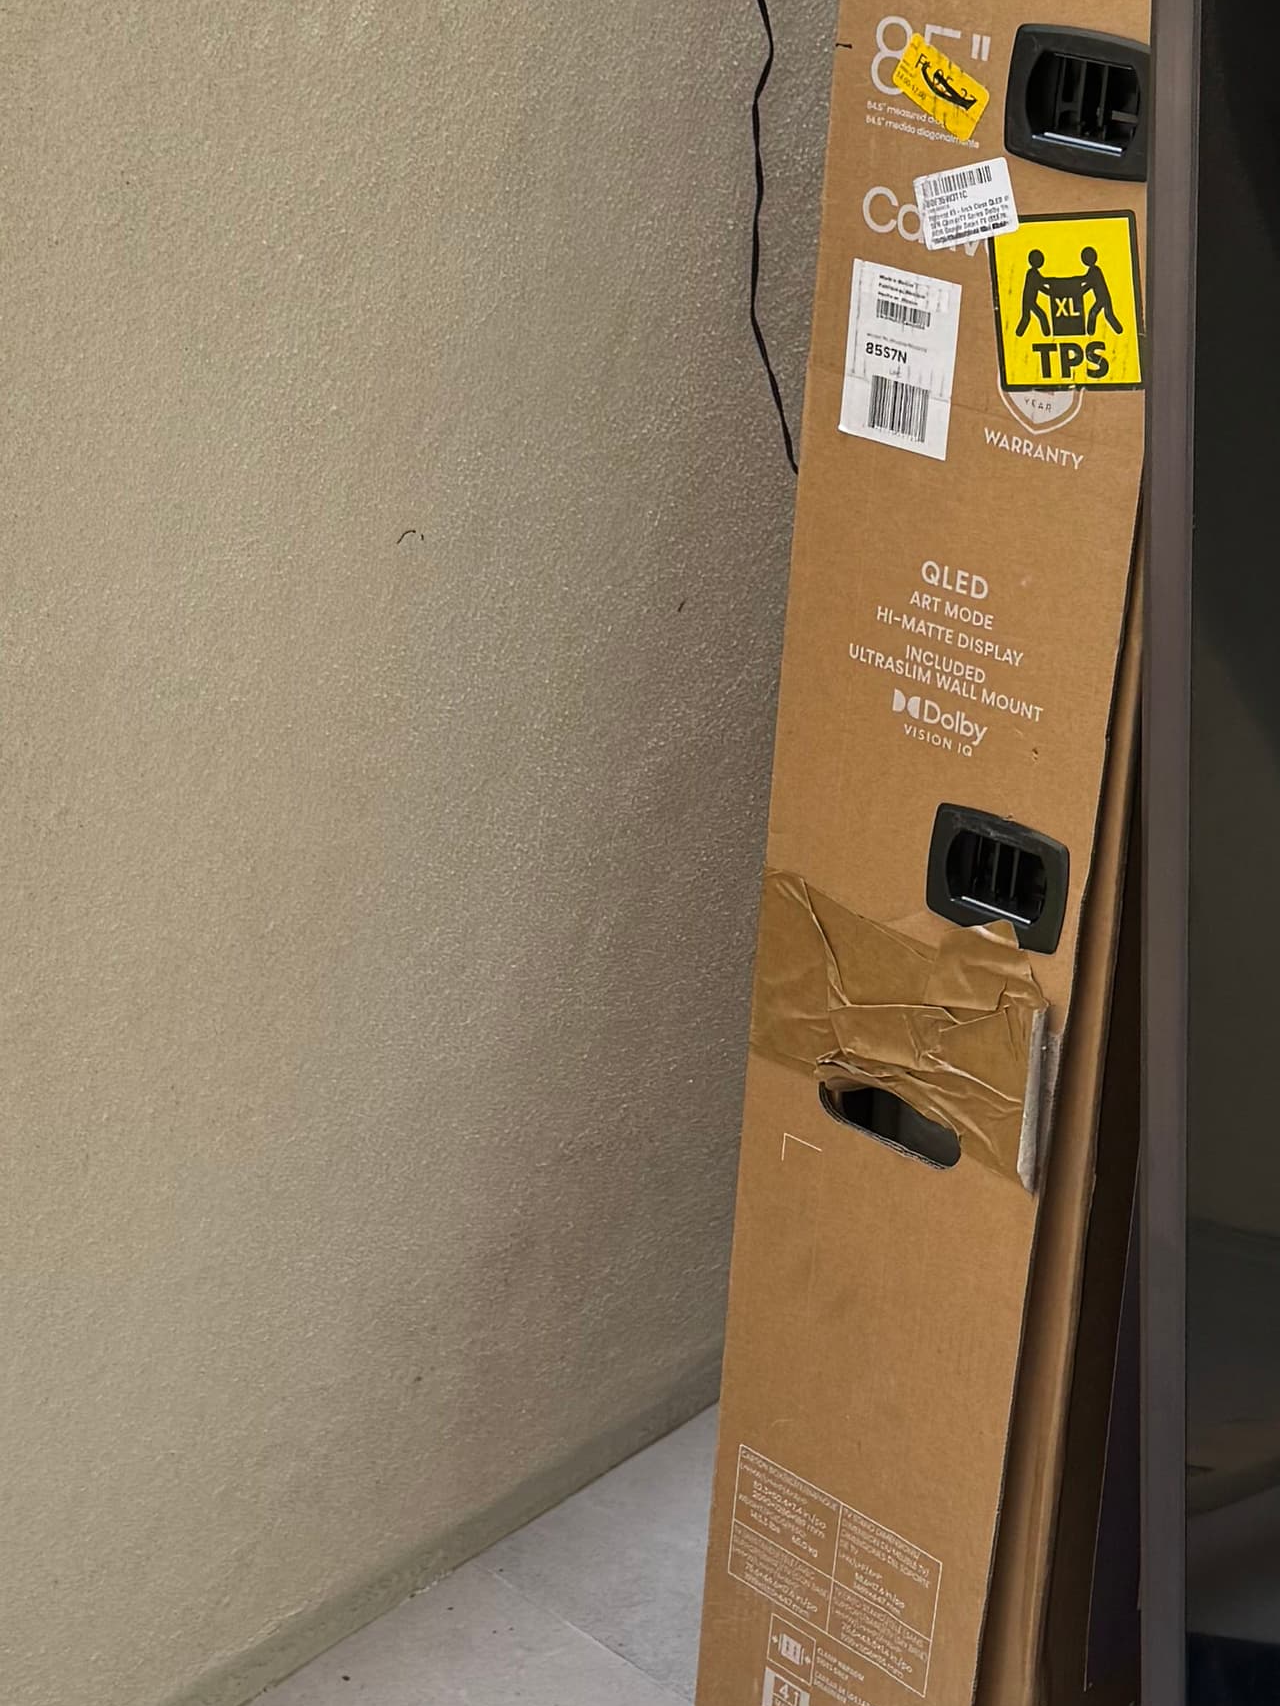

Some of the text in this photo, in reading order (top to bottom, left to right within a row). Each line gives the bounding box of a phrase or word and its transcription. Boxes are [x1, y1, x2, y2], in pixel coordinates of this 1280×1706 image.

[1055, 297, 1080, 317] XL
[865, 341, 907, 364] 85S7N
[1032, 341, 1109, 379] TPS
[984, 426, 1084, 470] WARRANTY
[921, 560, 988, 600] QLED
[910, 591, 994, 630] ART MODE
[877, 605, 1023, 667] HI-MATTE DISPLAY
[849, 643, 1044, 722] ULTRASLIM WALL MOUNT
[906, 644, 985, 684] INCLUDED
[904, 724, 973, 757] VISION IQ
[923, 699, 988, 746] Dolby
[778, 1684, 790, 1700] 4
